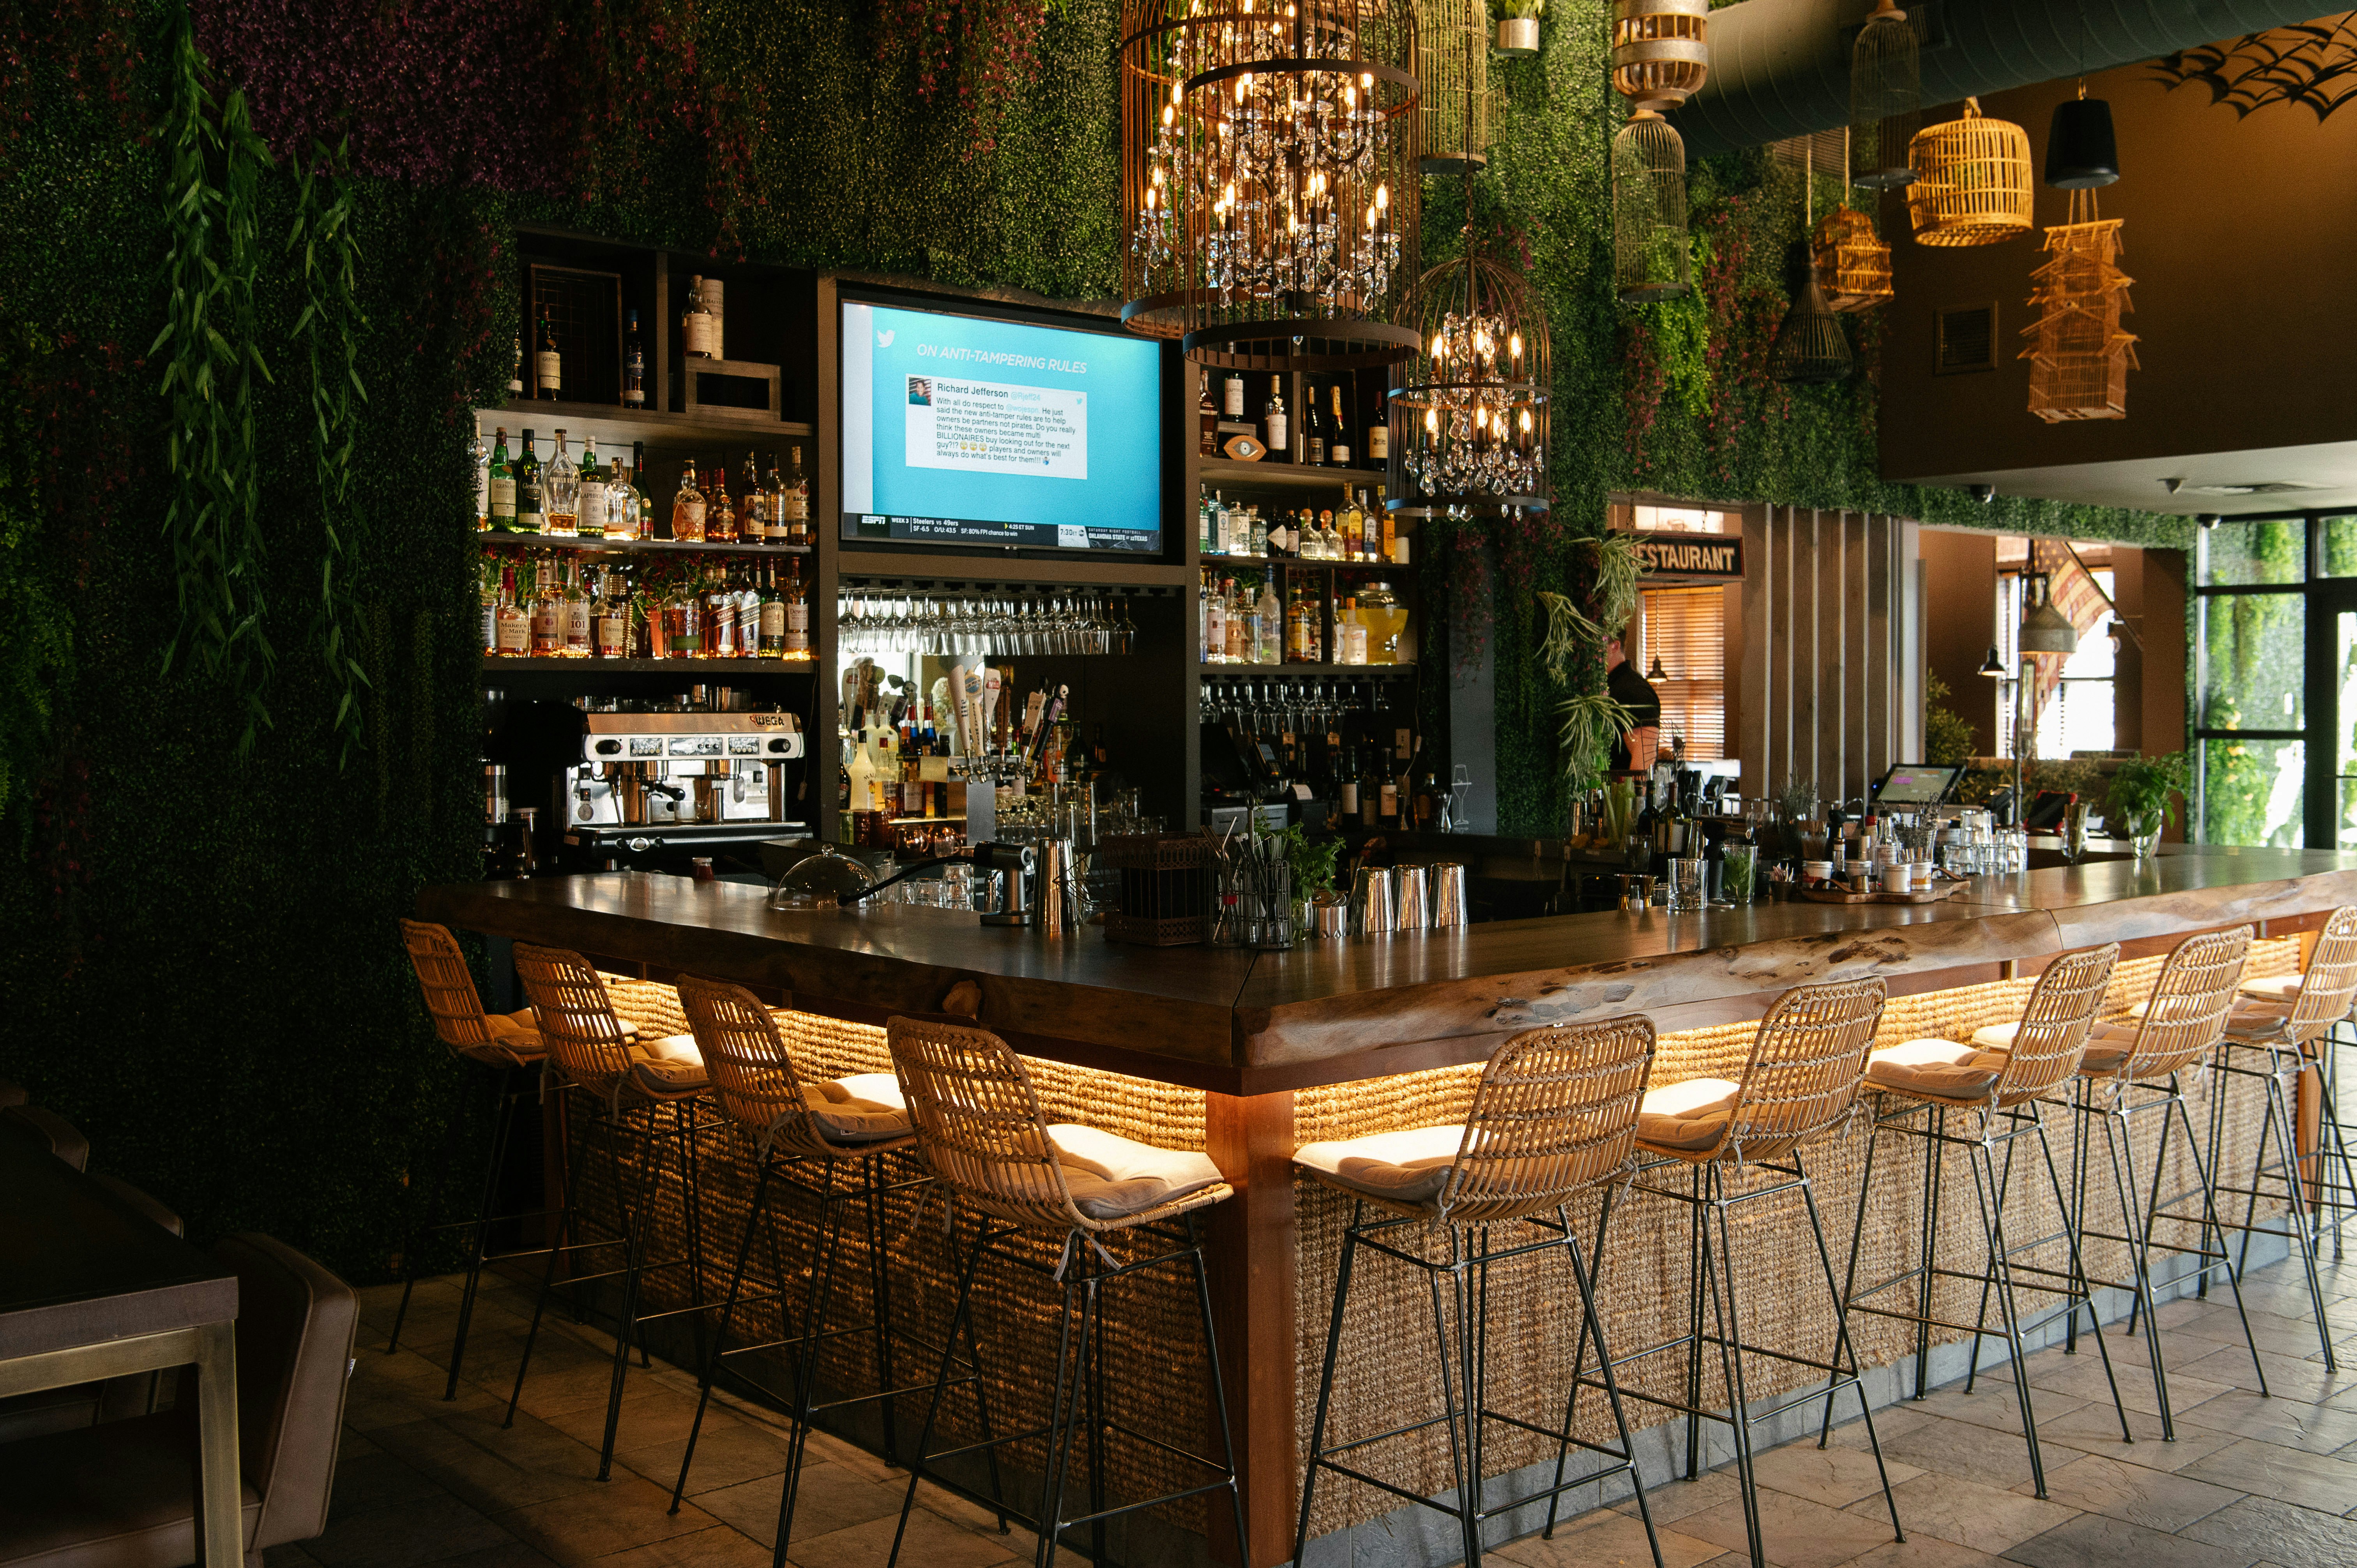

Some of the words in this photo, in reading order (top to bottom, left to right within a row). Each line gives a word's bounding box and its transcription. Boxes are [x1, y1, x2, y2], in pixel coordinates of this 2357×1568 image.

[917, 343, 937, 357] ON
[940, 346, 1046, 370] ANTI-TAMPERING
[1048, 358, 1088, 374] RULES
[937, 383, 968, 394] Richard
[972, 386, 1009, 398] Jefferson
[1011, 392, 1041, 401] @Rjeff24
[936, 397, 951, 405] With
[973, 402, 996, 410] respect
[979, 411, 1015, 420] anti-tamper
[1053, 417, 1066, 425] help
[1059, 427, 1076, 435] really
[937, 432, 984, 442] BILLIONAIRES
[986, 436, 997, 445] buy
[999, 437, 1022, 447] looking
[936, 441, 958, 449] guy?!?
[989, 445, 1012, 454] players
[936, 450, 959, 459] always
[862, 515, 885, 524] ESPN
[571, 620, 585, 629] 101
[755, 716, 785, 726] WEGA
